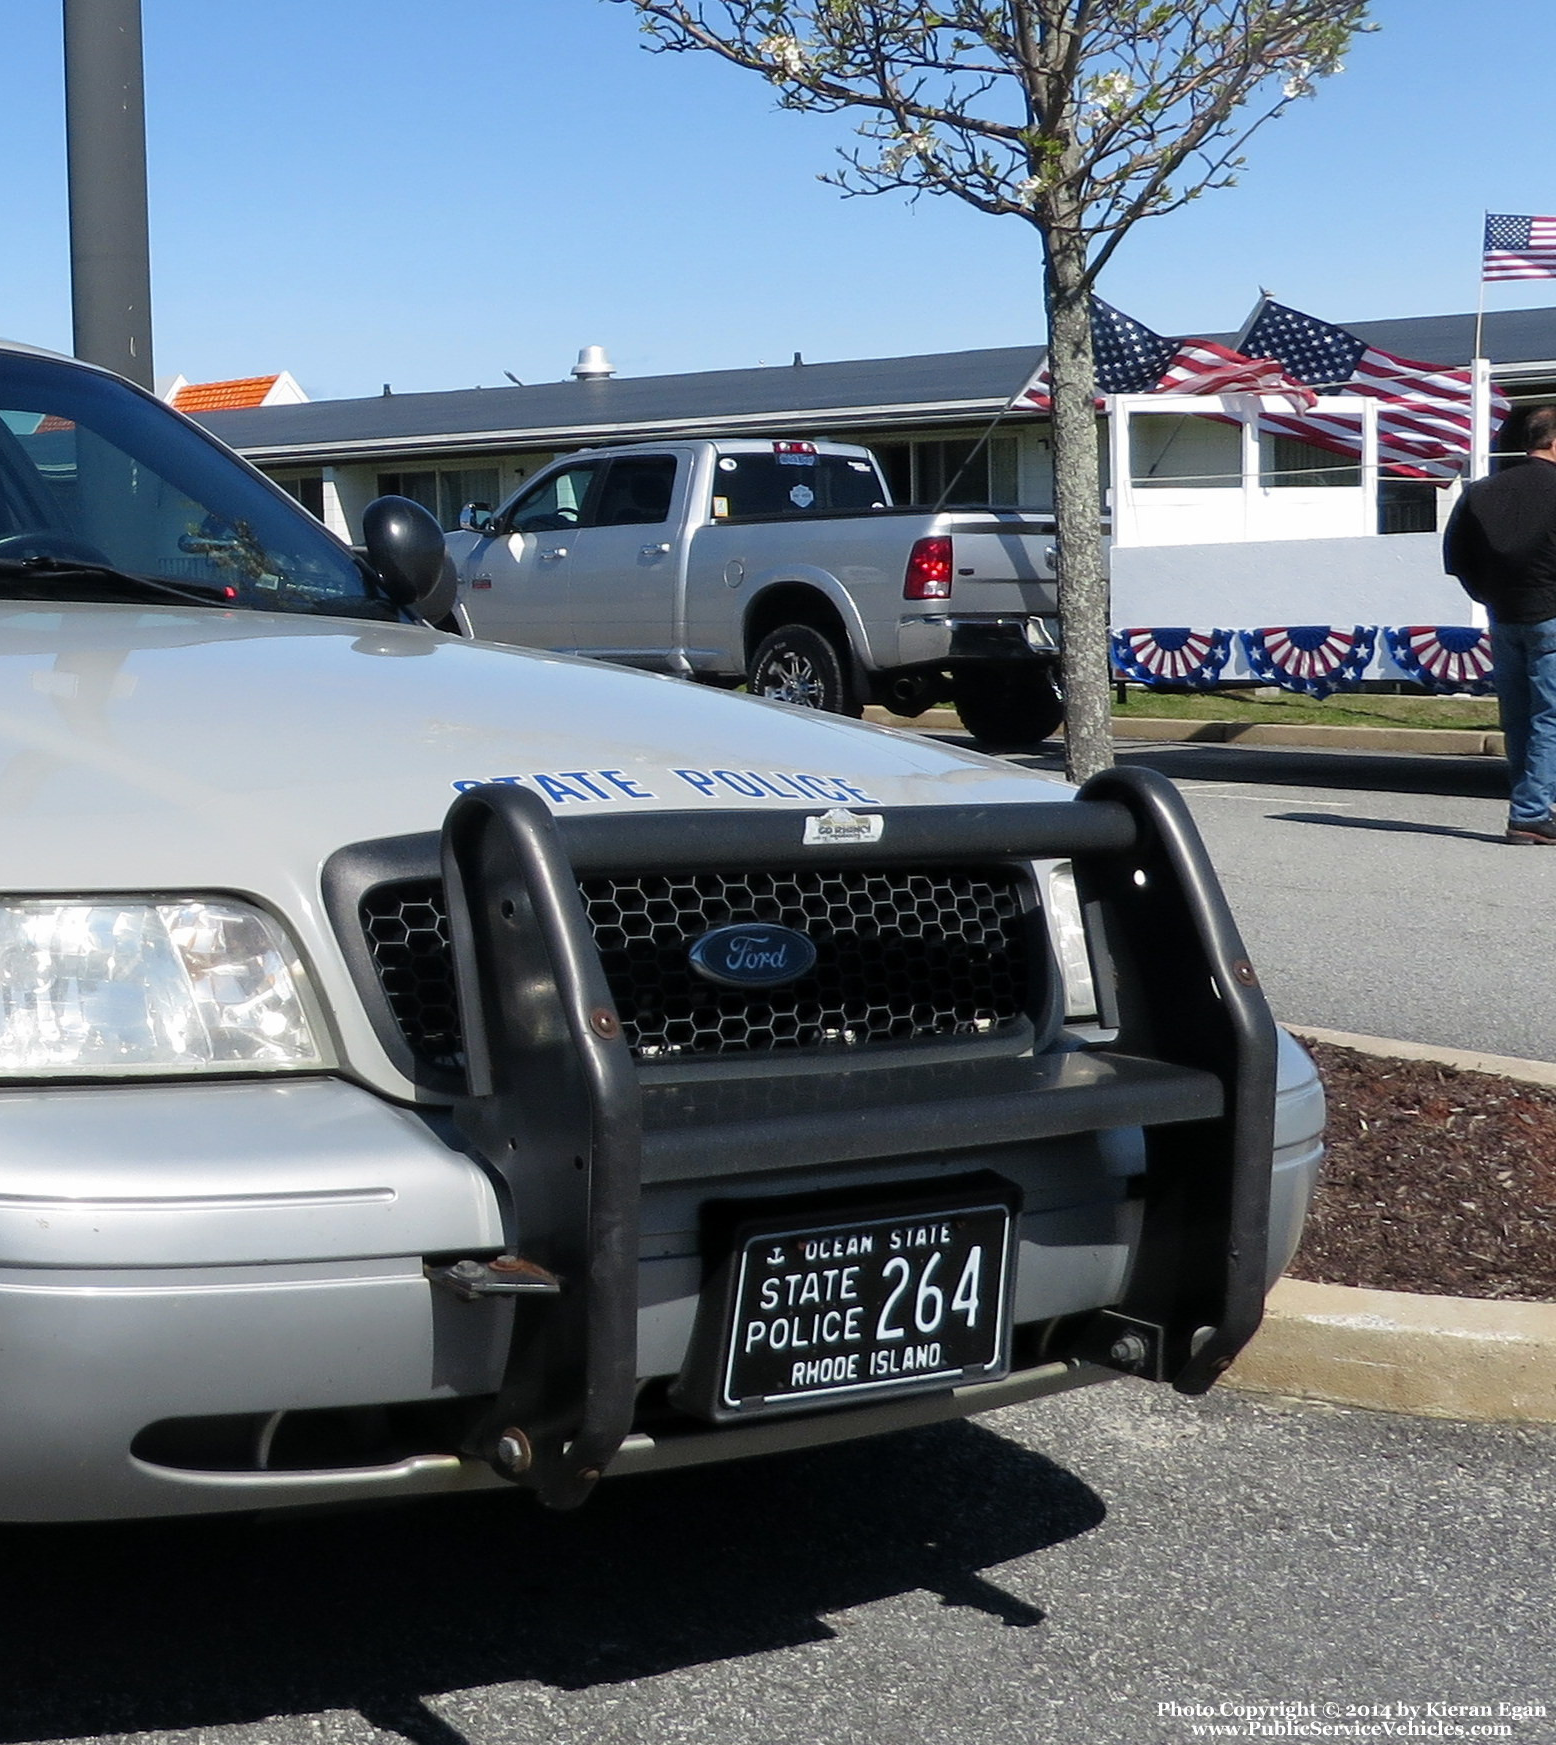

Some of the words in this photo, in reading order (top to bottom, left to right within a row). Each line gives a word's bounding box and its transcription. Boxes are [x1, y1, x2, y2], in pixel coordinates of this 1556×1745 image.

[666, 767, 885, 807] POLICE
[726, 936, 788, 970] Ford
[804, 1235, 873, 1261] OCEAN
[889, 1222, 951, 1250] STATE
[760, 1266, 860, 1310] STATE
[876, 1246, 981, 1341] 264
[745, 1306, 863, 1353] POLICE
[791, 1354, 859, 1386] RHODE
[869, 1343, 941, 1375] ISLAND
